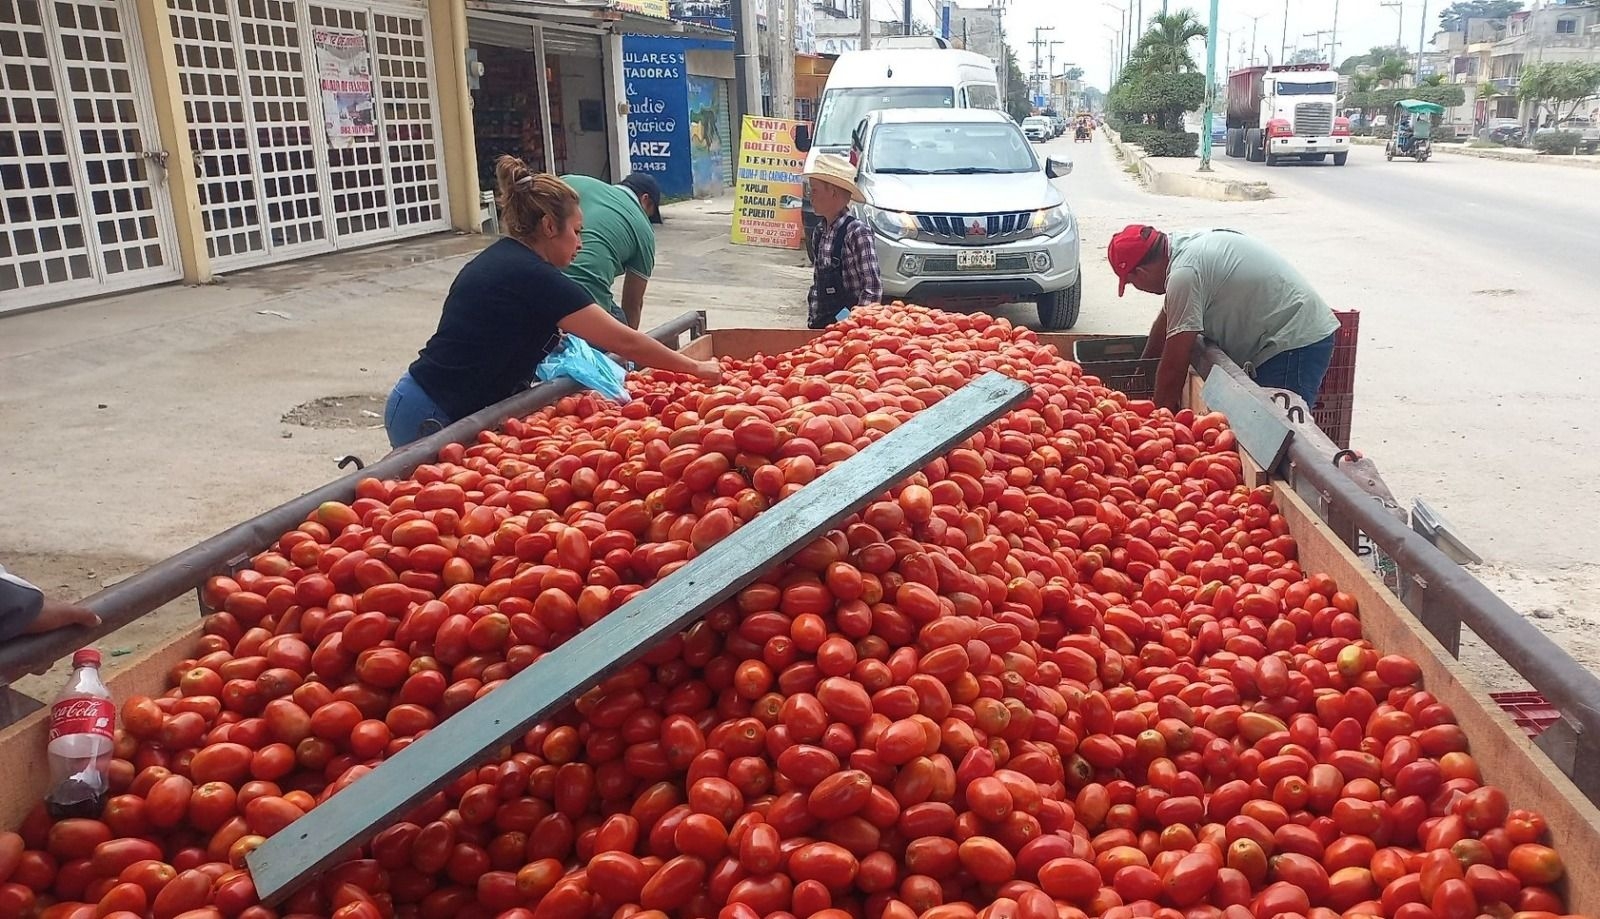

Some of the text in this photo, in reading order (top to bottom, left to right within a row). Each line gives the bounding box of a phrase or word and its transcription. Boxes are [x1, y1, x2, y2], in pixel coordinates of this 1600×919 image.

[623, 52, 676, 64] ULARES
[626, 82, 638, 96] &
[752, 120, 787, 131] VENTA
[762, 131, 775, 141] DE
[744, 141, 791, 153] BOLETOS
[745, 155, 804, 168] DESTINOS
